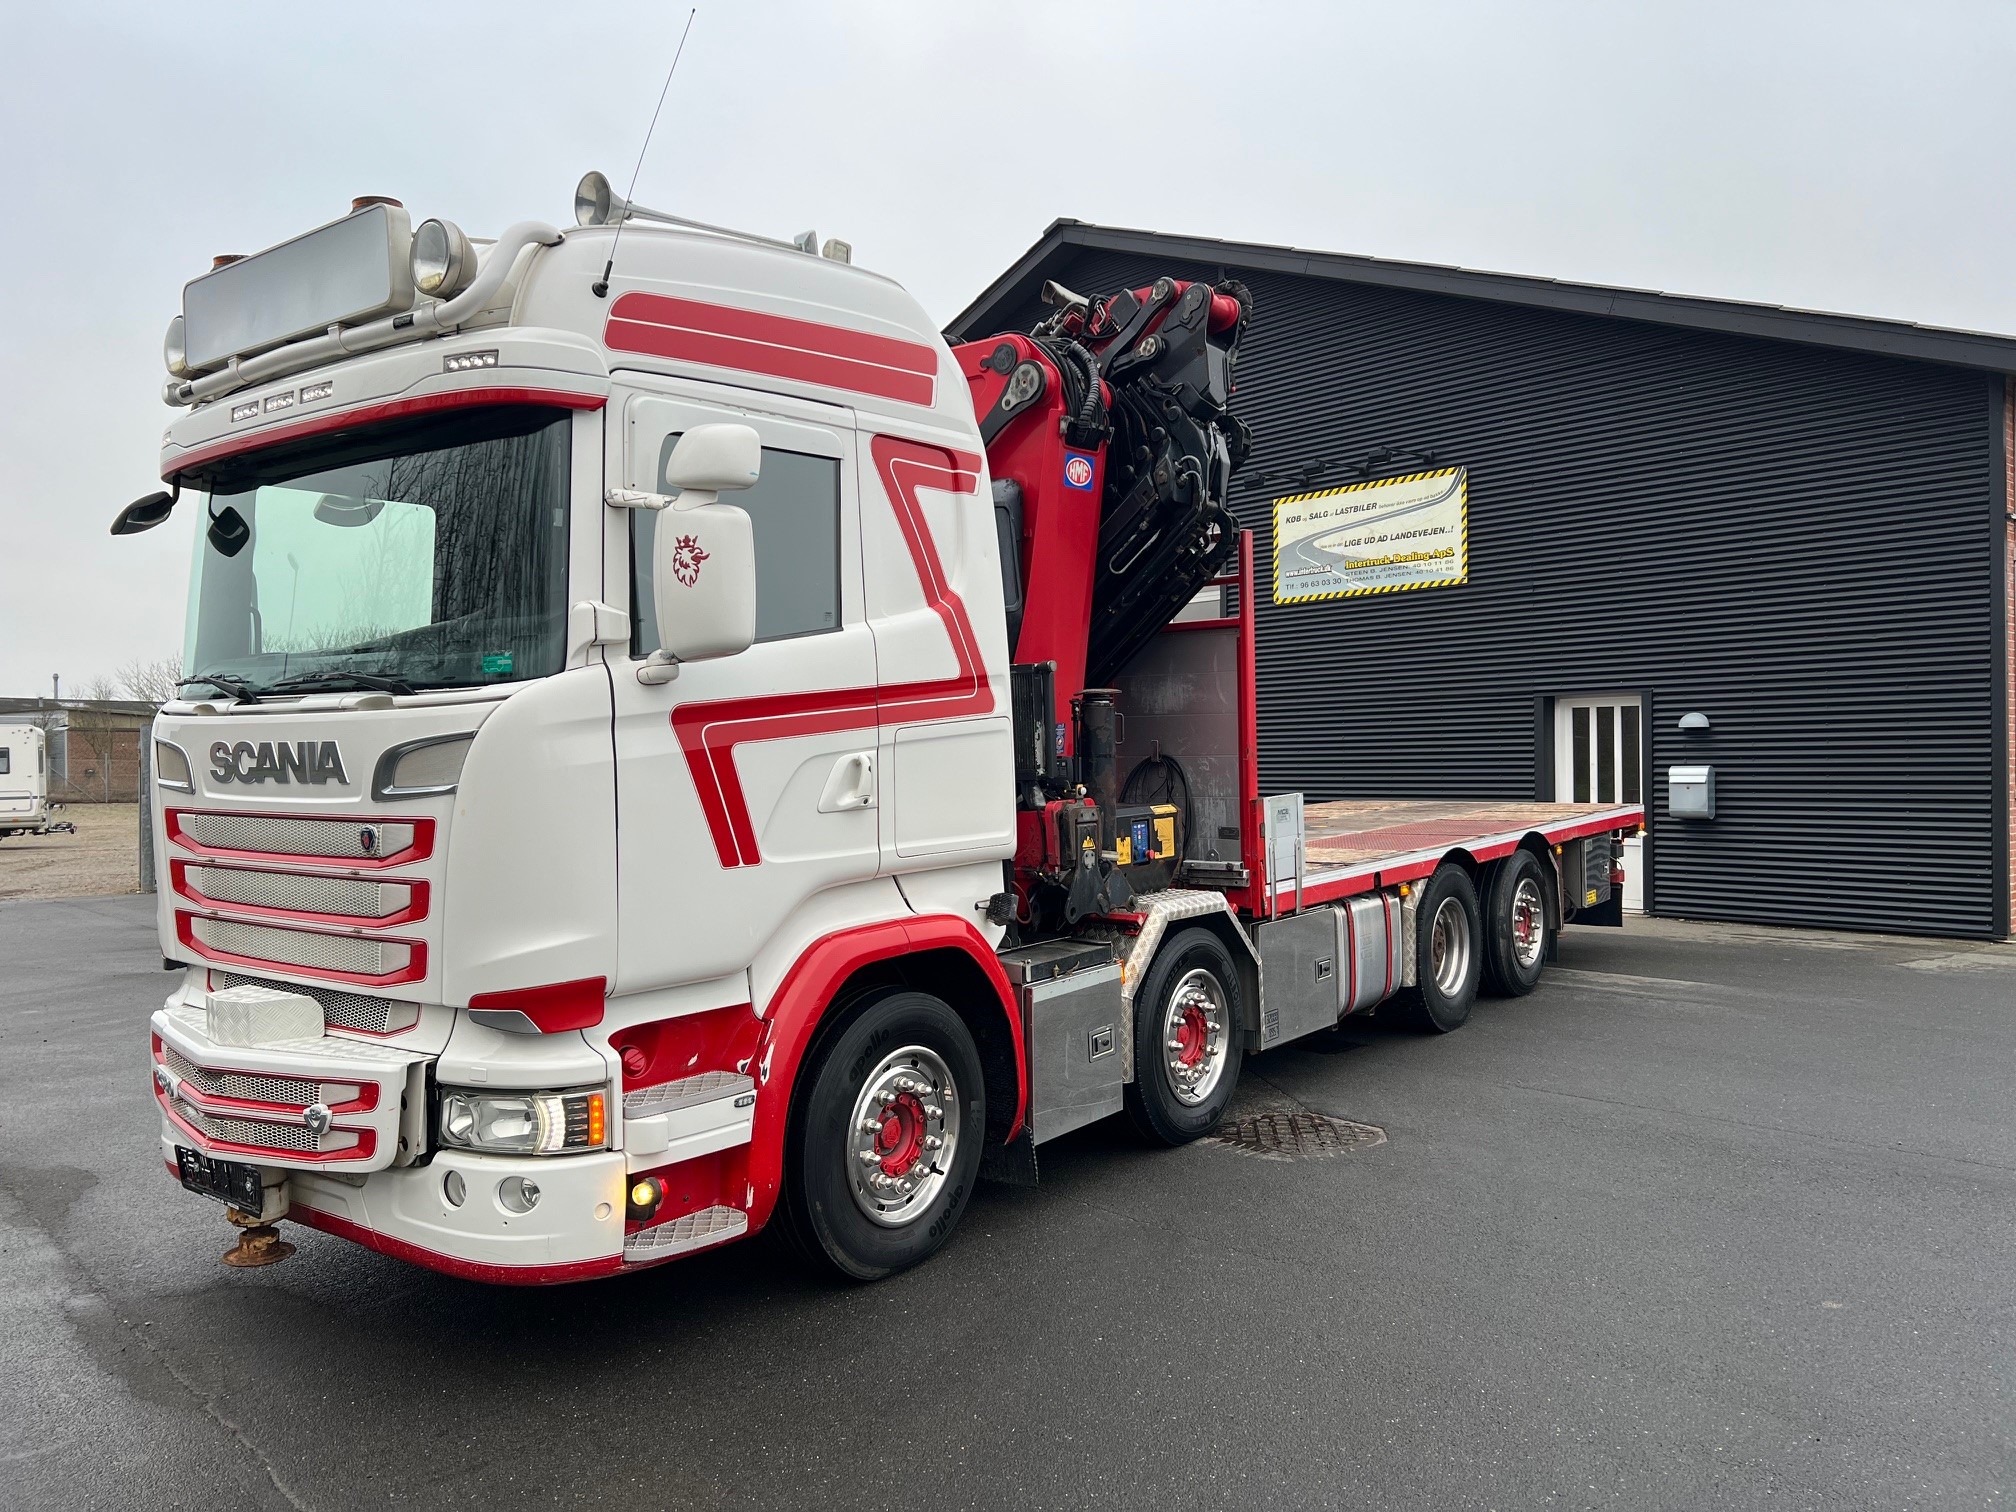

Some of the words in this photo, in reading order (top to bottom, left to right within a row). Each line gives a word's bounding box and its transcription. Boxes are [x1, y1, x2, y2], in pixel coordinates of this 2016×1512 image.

[1069, 461, 1089, 483] HMF
[1309, 511, 1328, 520] SALG
[1335, 502, 1377, 515] LASTBILER
[1344, 538, 1362, 547] LIGE
[1377, 535, 1388, 543] AD
[1345, 555, 1391, 570] Intertruck
[1393, 551, 1431, 563] Dealing
[1432, 547, 1455, 559] ApS
[209, 739, 350, 785] SCANIA
[849, 1028, 890, 1083] apollo
[928, 1184, 964, 1239] apollo
